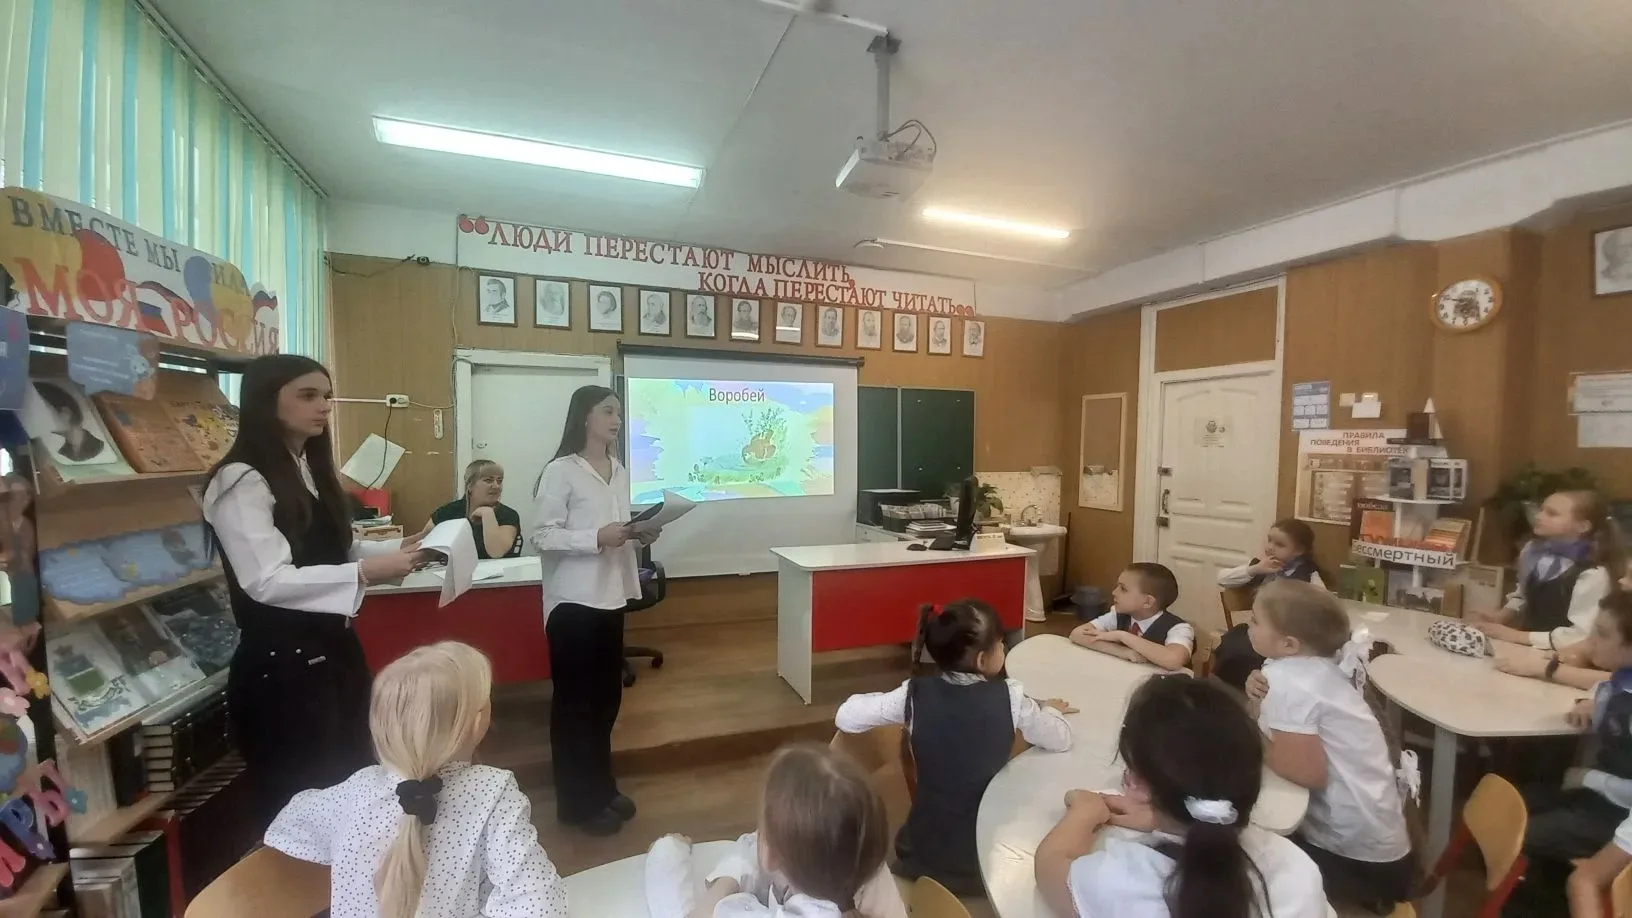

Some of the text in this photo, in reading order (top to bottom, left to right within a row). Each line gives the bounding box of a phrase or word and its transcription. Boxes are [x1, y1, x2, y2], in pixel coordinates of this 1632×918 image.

[143, 238, 182, 273] МЫ
[583, 233, 735, 271] ПЕРЕСТАЮТ
[697, 271, 771, 298] КОГДА
[773, 279, 887, 310] ПЕРЕСТАЮТ
[12, 256, 279, 357] МОЯ РОССИЯ
[709, 387, 765, 404] Воробей
[1310, 439, 1360, 447] ПОВЕДЕНИЯ
[1342, 431, 1385, 439] ПРАВИЛА
[1356, 446, 1408, 455] БИБЛИОТЕК
